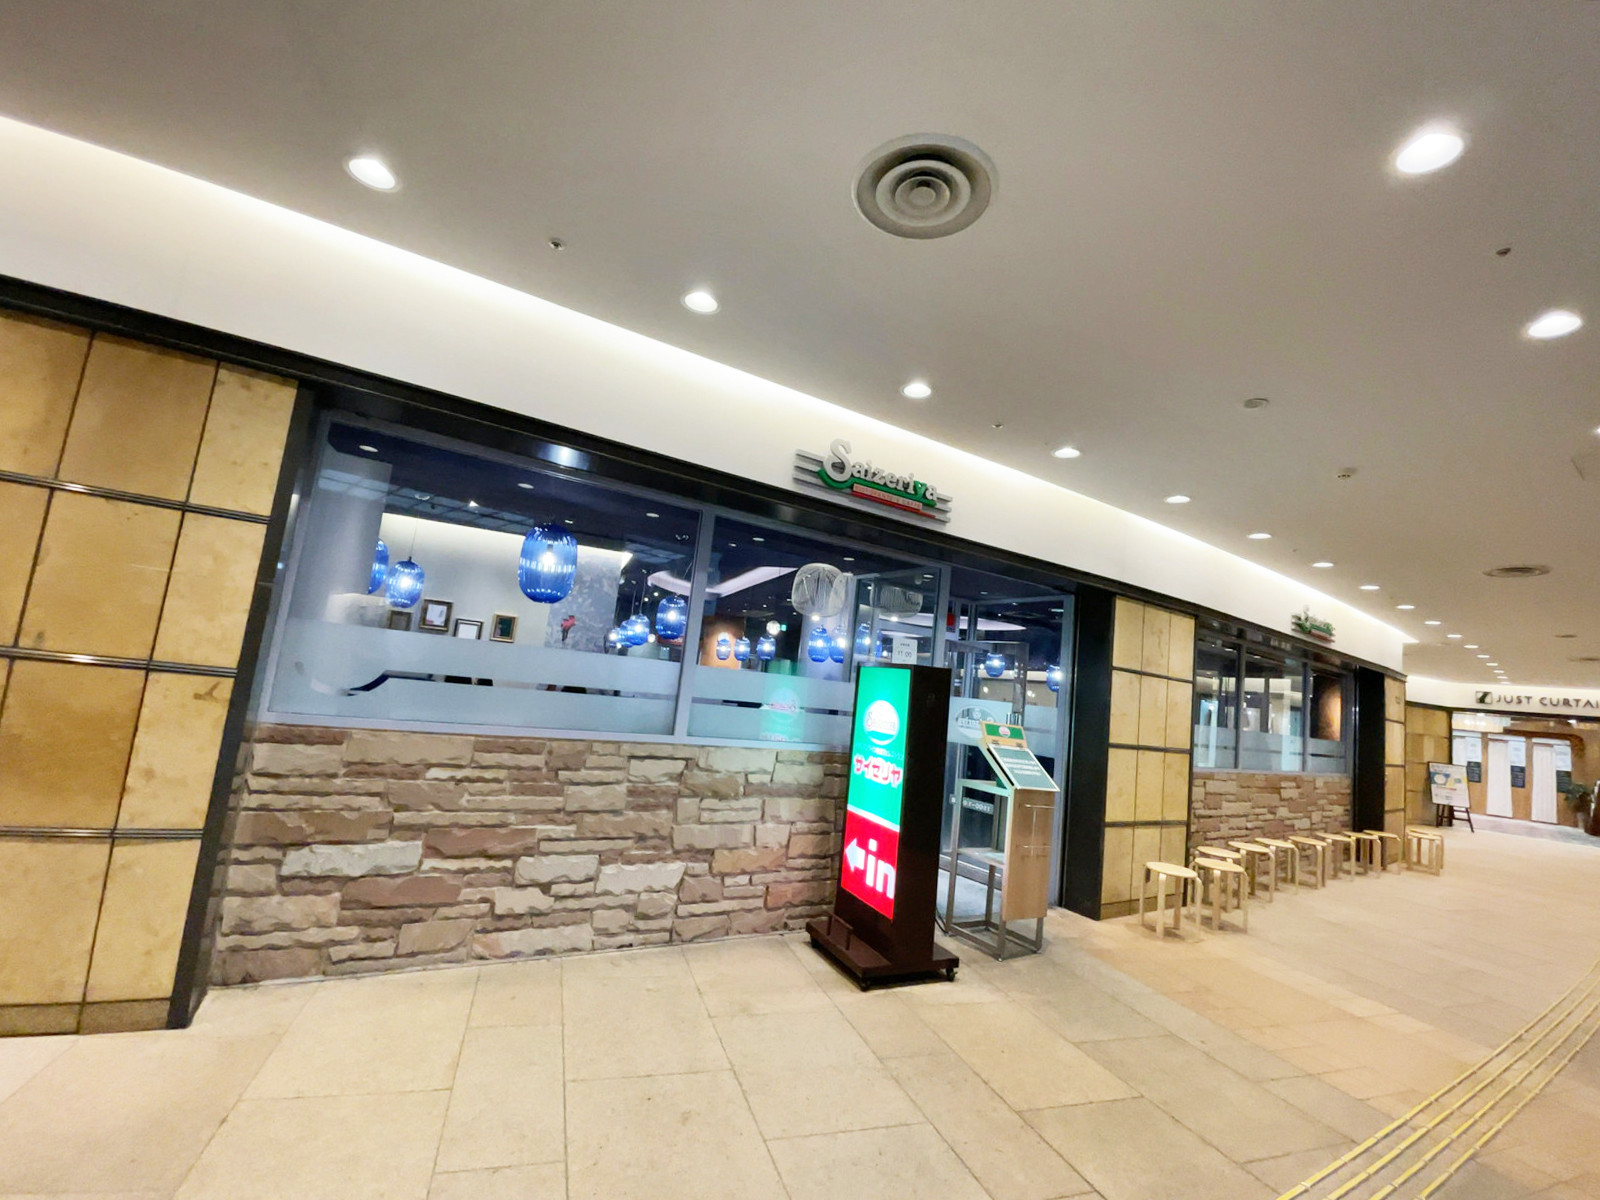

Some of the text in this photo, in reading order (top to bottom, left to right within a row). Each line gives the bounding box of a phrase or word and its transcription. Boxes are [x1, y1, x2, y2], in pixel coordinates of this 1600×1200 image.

[823, 438, 939, 501] Saizeriya
[1496, 694, 1533, 705] JUST
[865, 838, 896, 900] in
